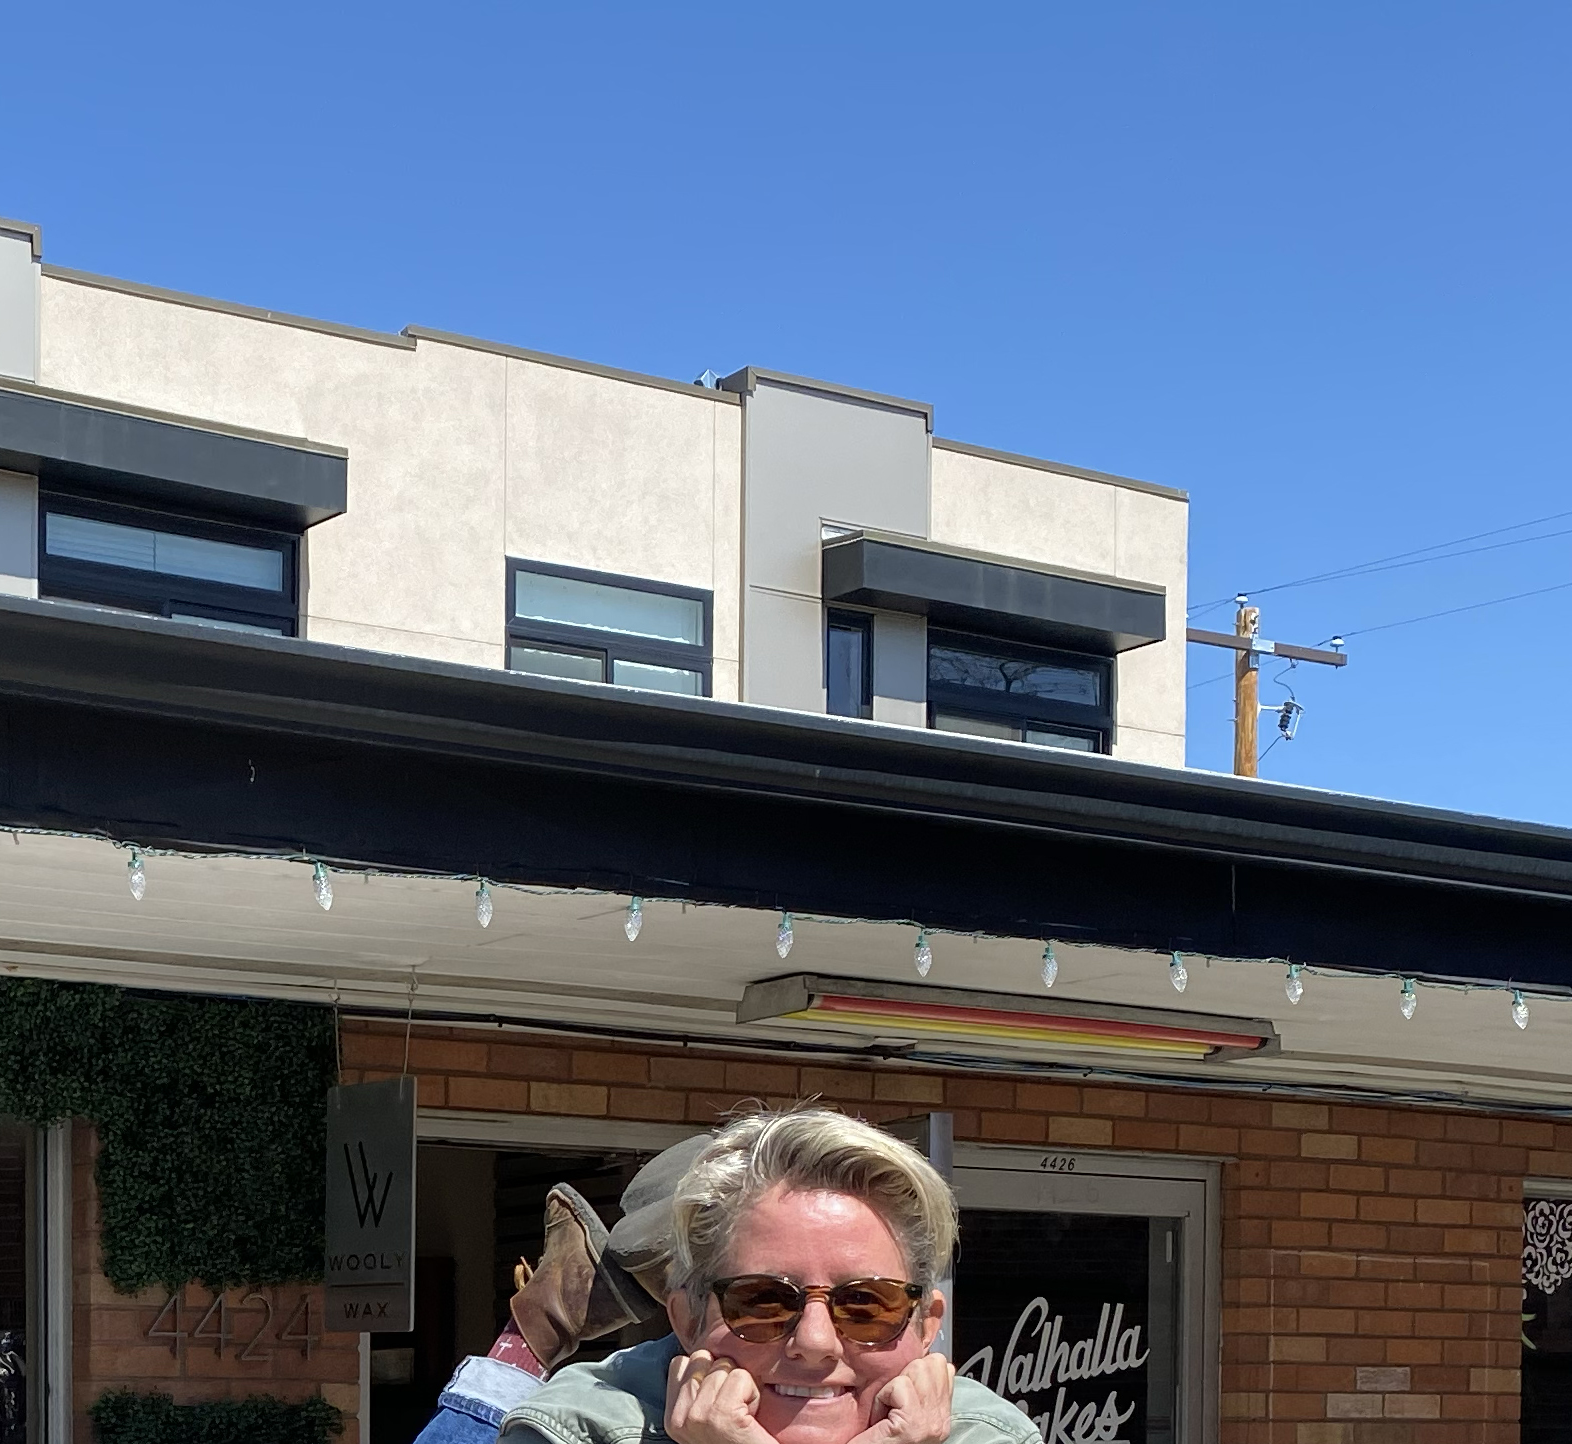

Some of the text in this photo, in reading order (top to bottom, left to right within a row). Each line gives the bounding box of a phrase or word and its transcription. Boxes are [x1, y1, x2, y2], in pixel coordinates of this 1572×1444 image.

[1040, 1156, 1076, 1171] 4426
[328, 1251, 406, 1271] WOOLY
[343, 1302, 389, 1320] WAX
[147, 1293, 319, 1362] 4424
[956, 1297, 1150, 1395] Valhalla
